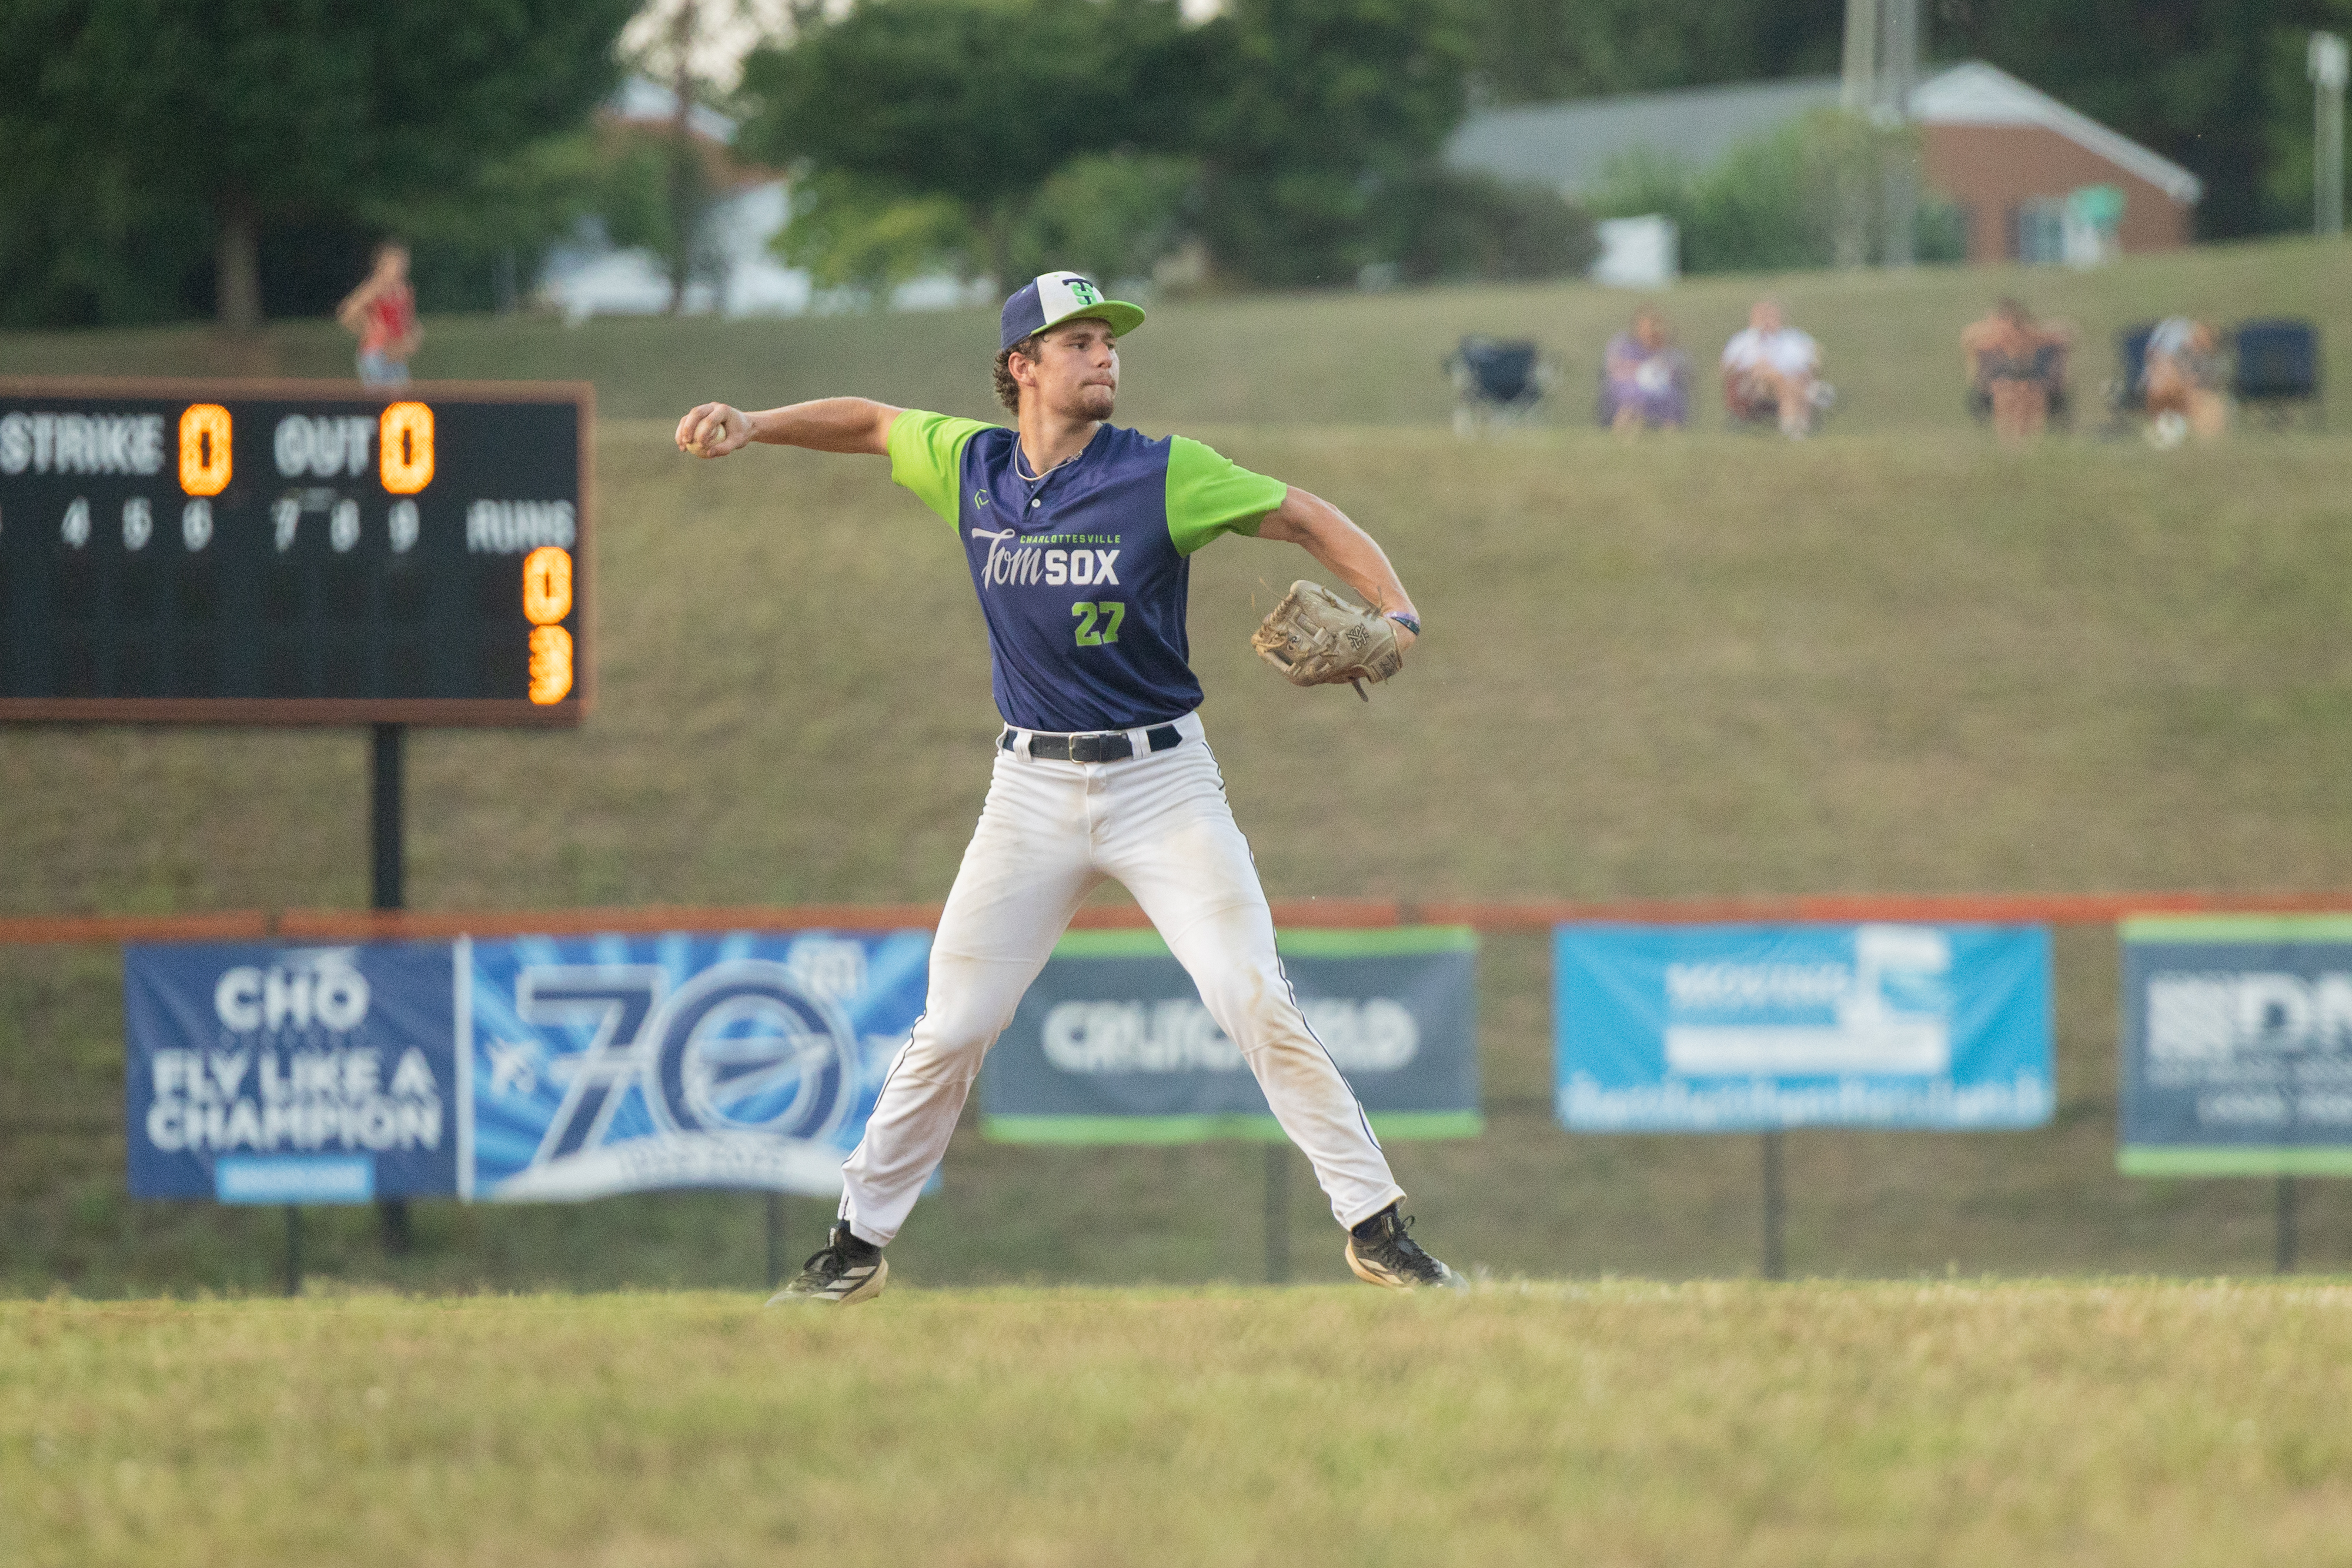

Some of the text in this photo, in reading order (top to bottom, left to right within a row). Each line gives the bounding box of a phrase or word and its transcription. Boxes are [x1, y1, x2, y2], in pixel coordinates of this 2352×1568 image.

[0, 402, 435, 496] STRIKE 0 OUT 0
[61, 497, 576, 553] 4 5 6 7 8 9 RUNS
[1020, 534, 1121, 544] CHARLOTTESVILLE
[523, 546, 573, 625] 0
[1071, 601, 1125, 647] 27
[214, 964, 372, 1032] CHO
[152, 1045, 439, 1101] FLY LIKE A
[147, 1097, 443, 1151] CHAMPION
